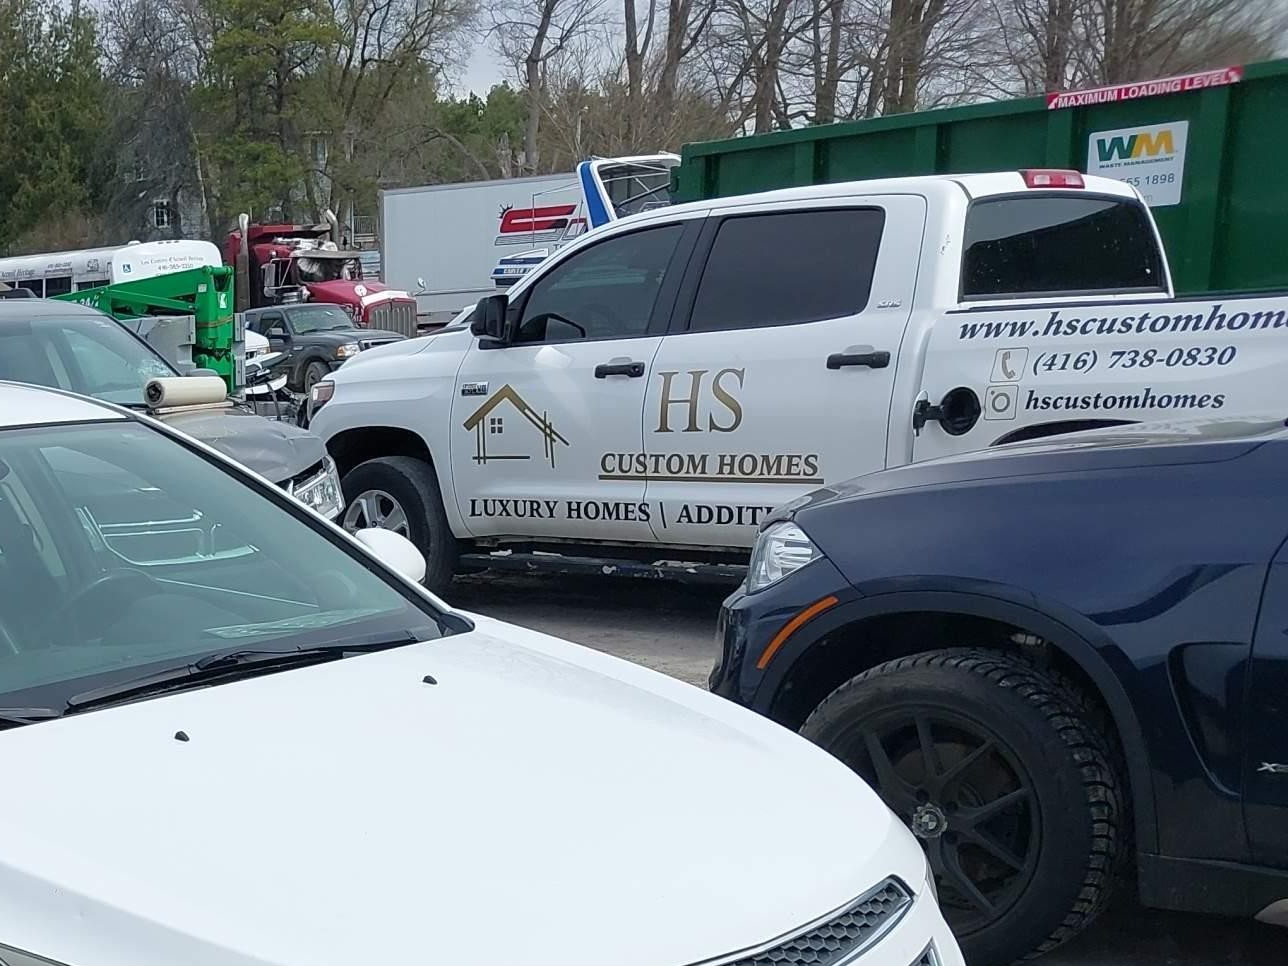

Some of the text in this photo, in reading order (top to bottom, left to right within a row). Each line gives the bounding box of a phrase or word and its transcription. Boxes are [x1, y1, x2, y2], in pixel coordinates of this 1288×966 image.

[1057, 73, 1229, 109] MAXIMUM LOADING LEVEL
[1096, 129, 1175, 161] WM
[1145, 173, 1175, 185] 1898
[959, 305, 1288, 340] www.hscustomhom
[1032, 345, 1237, 376] (416) 738-0830
[653, 367, 746, 434] HS
[1024, 388, 1226, 411] hscustomhomes
[599, 452, 819, 477] CUSTOM HOMES
[468, 498, 559, 518] LUXURY
[566, 501, 651, 522] HOMES
